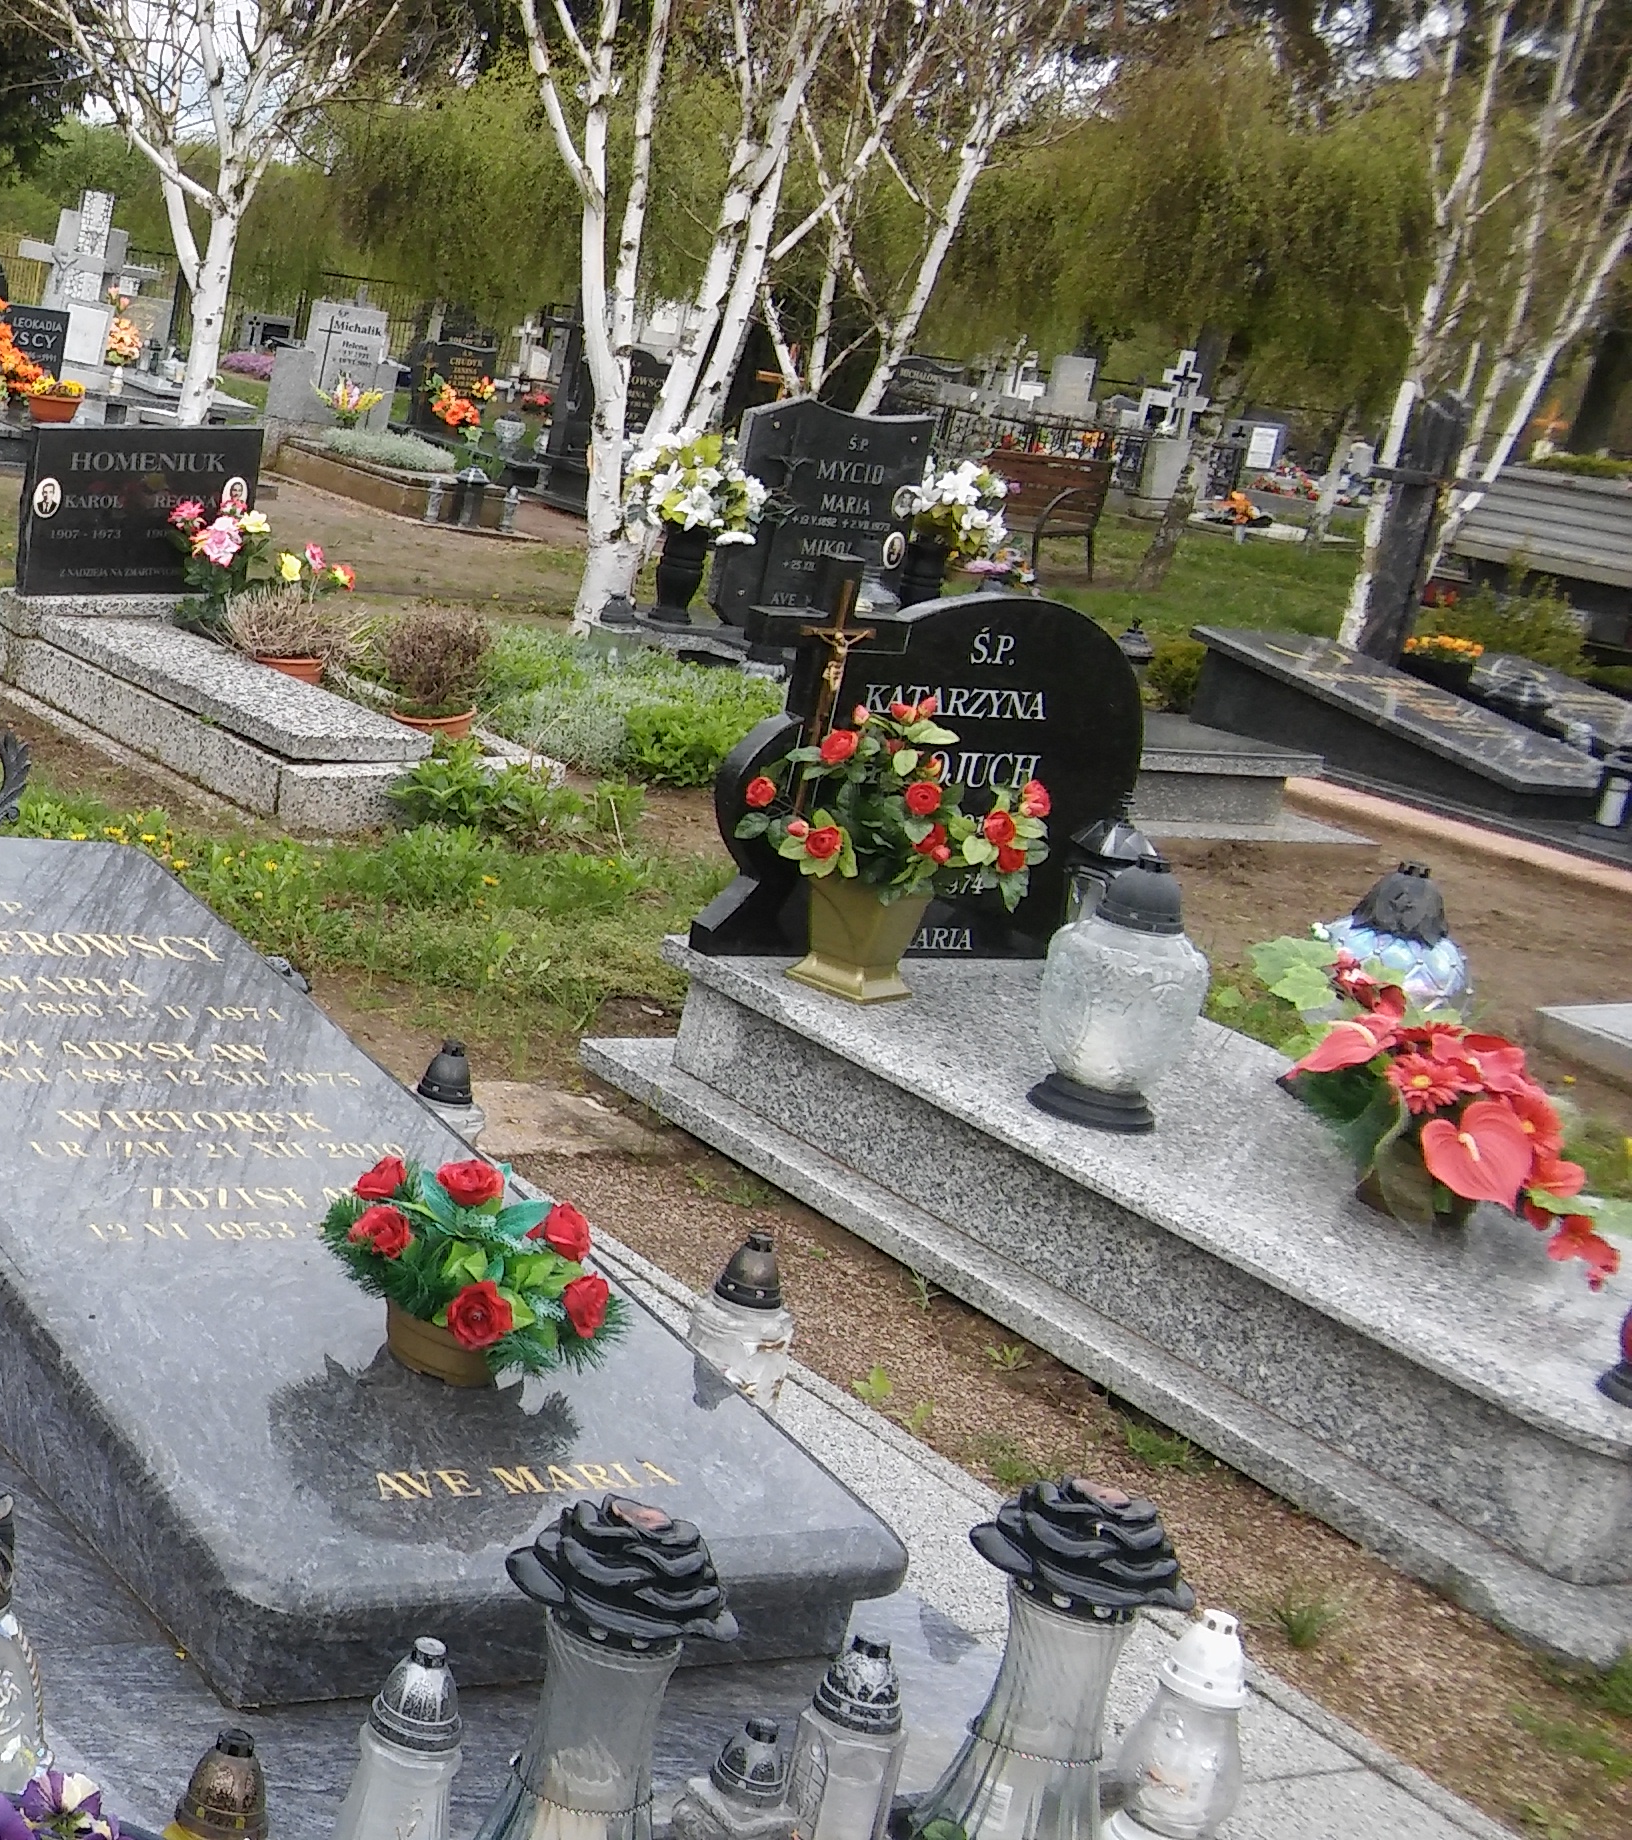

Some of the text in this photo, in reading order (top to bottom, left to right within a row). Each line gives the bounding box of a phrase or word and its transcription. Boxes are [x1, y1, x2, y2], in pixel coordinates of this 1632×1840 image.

[13, 316, 63, 333] LEOKADIA
[333, 320, 382, 337] Michalik
[70, 451, 227, 474] HOMENIUK
[820, 493, 872, 516] MARIA
[970, 627, 1016, 666] Ś.P.
[864, 684, 1047, 721] KATARZYNA
[909, 926, 973, 951] ARIA
[56, 1109, 332, 1133] WIKTOREK
[138, 1186, 353, 1210] ZDZISŁA
[374, 1459, 682, 1501] AVE MARIA
